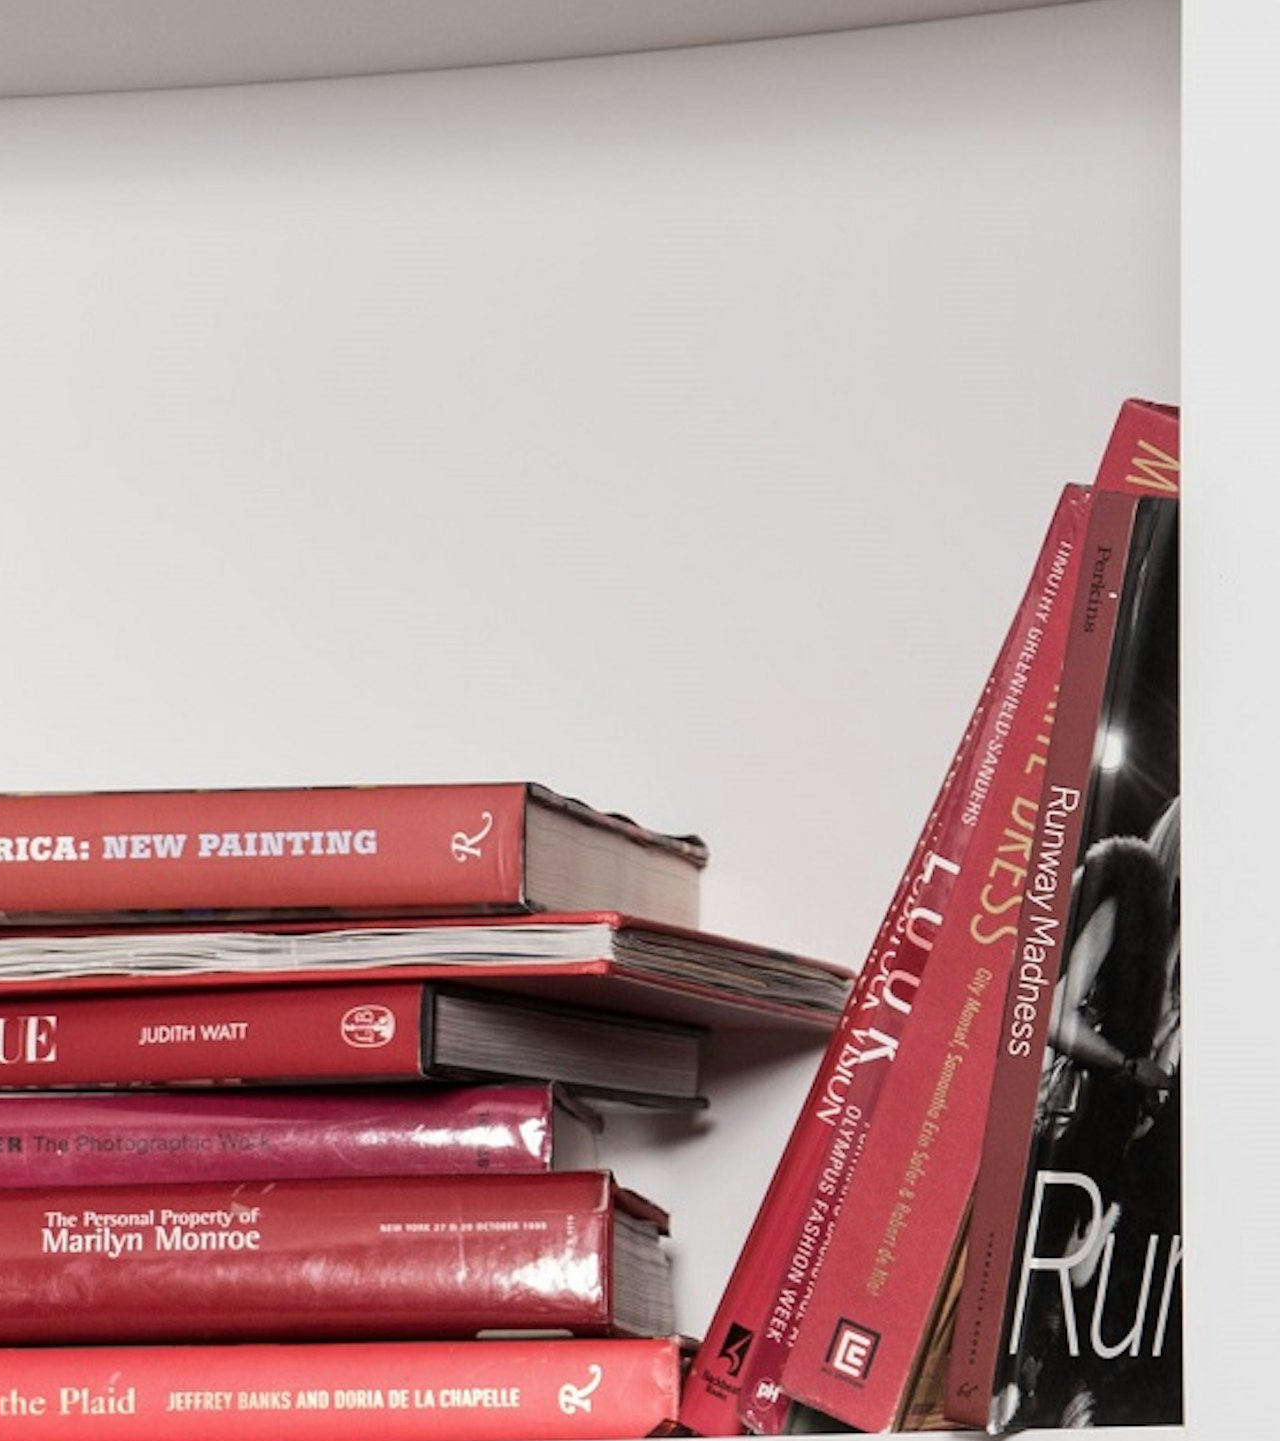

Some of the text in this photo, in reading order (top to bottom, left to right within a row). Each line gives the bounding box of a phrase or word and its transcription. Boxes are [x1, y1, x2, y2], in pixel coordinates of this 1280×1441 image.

[102, 834, 187, 861] NEW
[199, 829, 378, 859] PAINTING
[1007, 786, 1080, 1058] Runway Madness
[139, 1025, 195, 1046] JUDITH
[201, 1021, 249, 1042] WATT
[44, 1208, 260, 1229] The Personal Property of
[764, 1105, 860, 1344] OLYMPUS FASHION WEEK
[42, 1225, 260, 1258] Marilyn Monroe
[58, 1385, 136, 1417] Plaid
[167, 1391, 232, 1412] JEFFREY
[238, 1391, 292, 1412] BANKS
[296, 1391, 330, 1411] AND
[334, 1389, 385, 1410] DORIA
[389, 1389, 409, 1409] DE
[414, 1389, 434, 1409] LA
[440, 1388, 520, 1409] CHAPELLE
